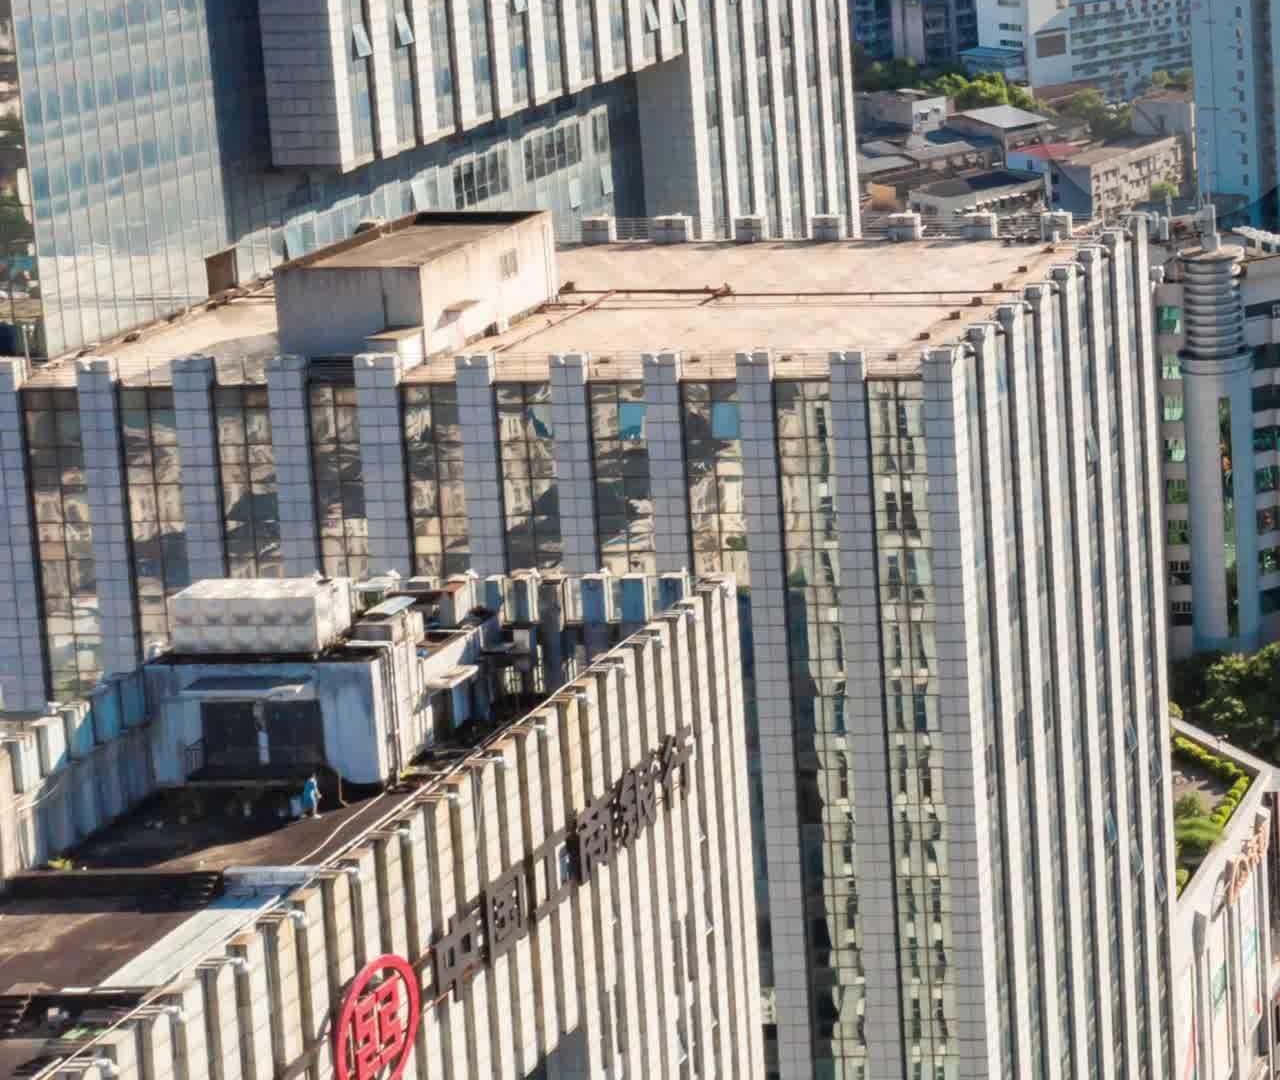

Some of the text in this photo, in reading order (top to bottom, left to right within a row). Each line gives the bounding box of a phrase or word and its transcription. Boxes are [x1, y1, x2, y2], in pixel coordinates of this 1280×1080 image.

[432, 725, 694, 1003] 中国工商银行
